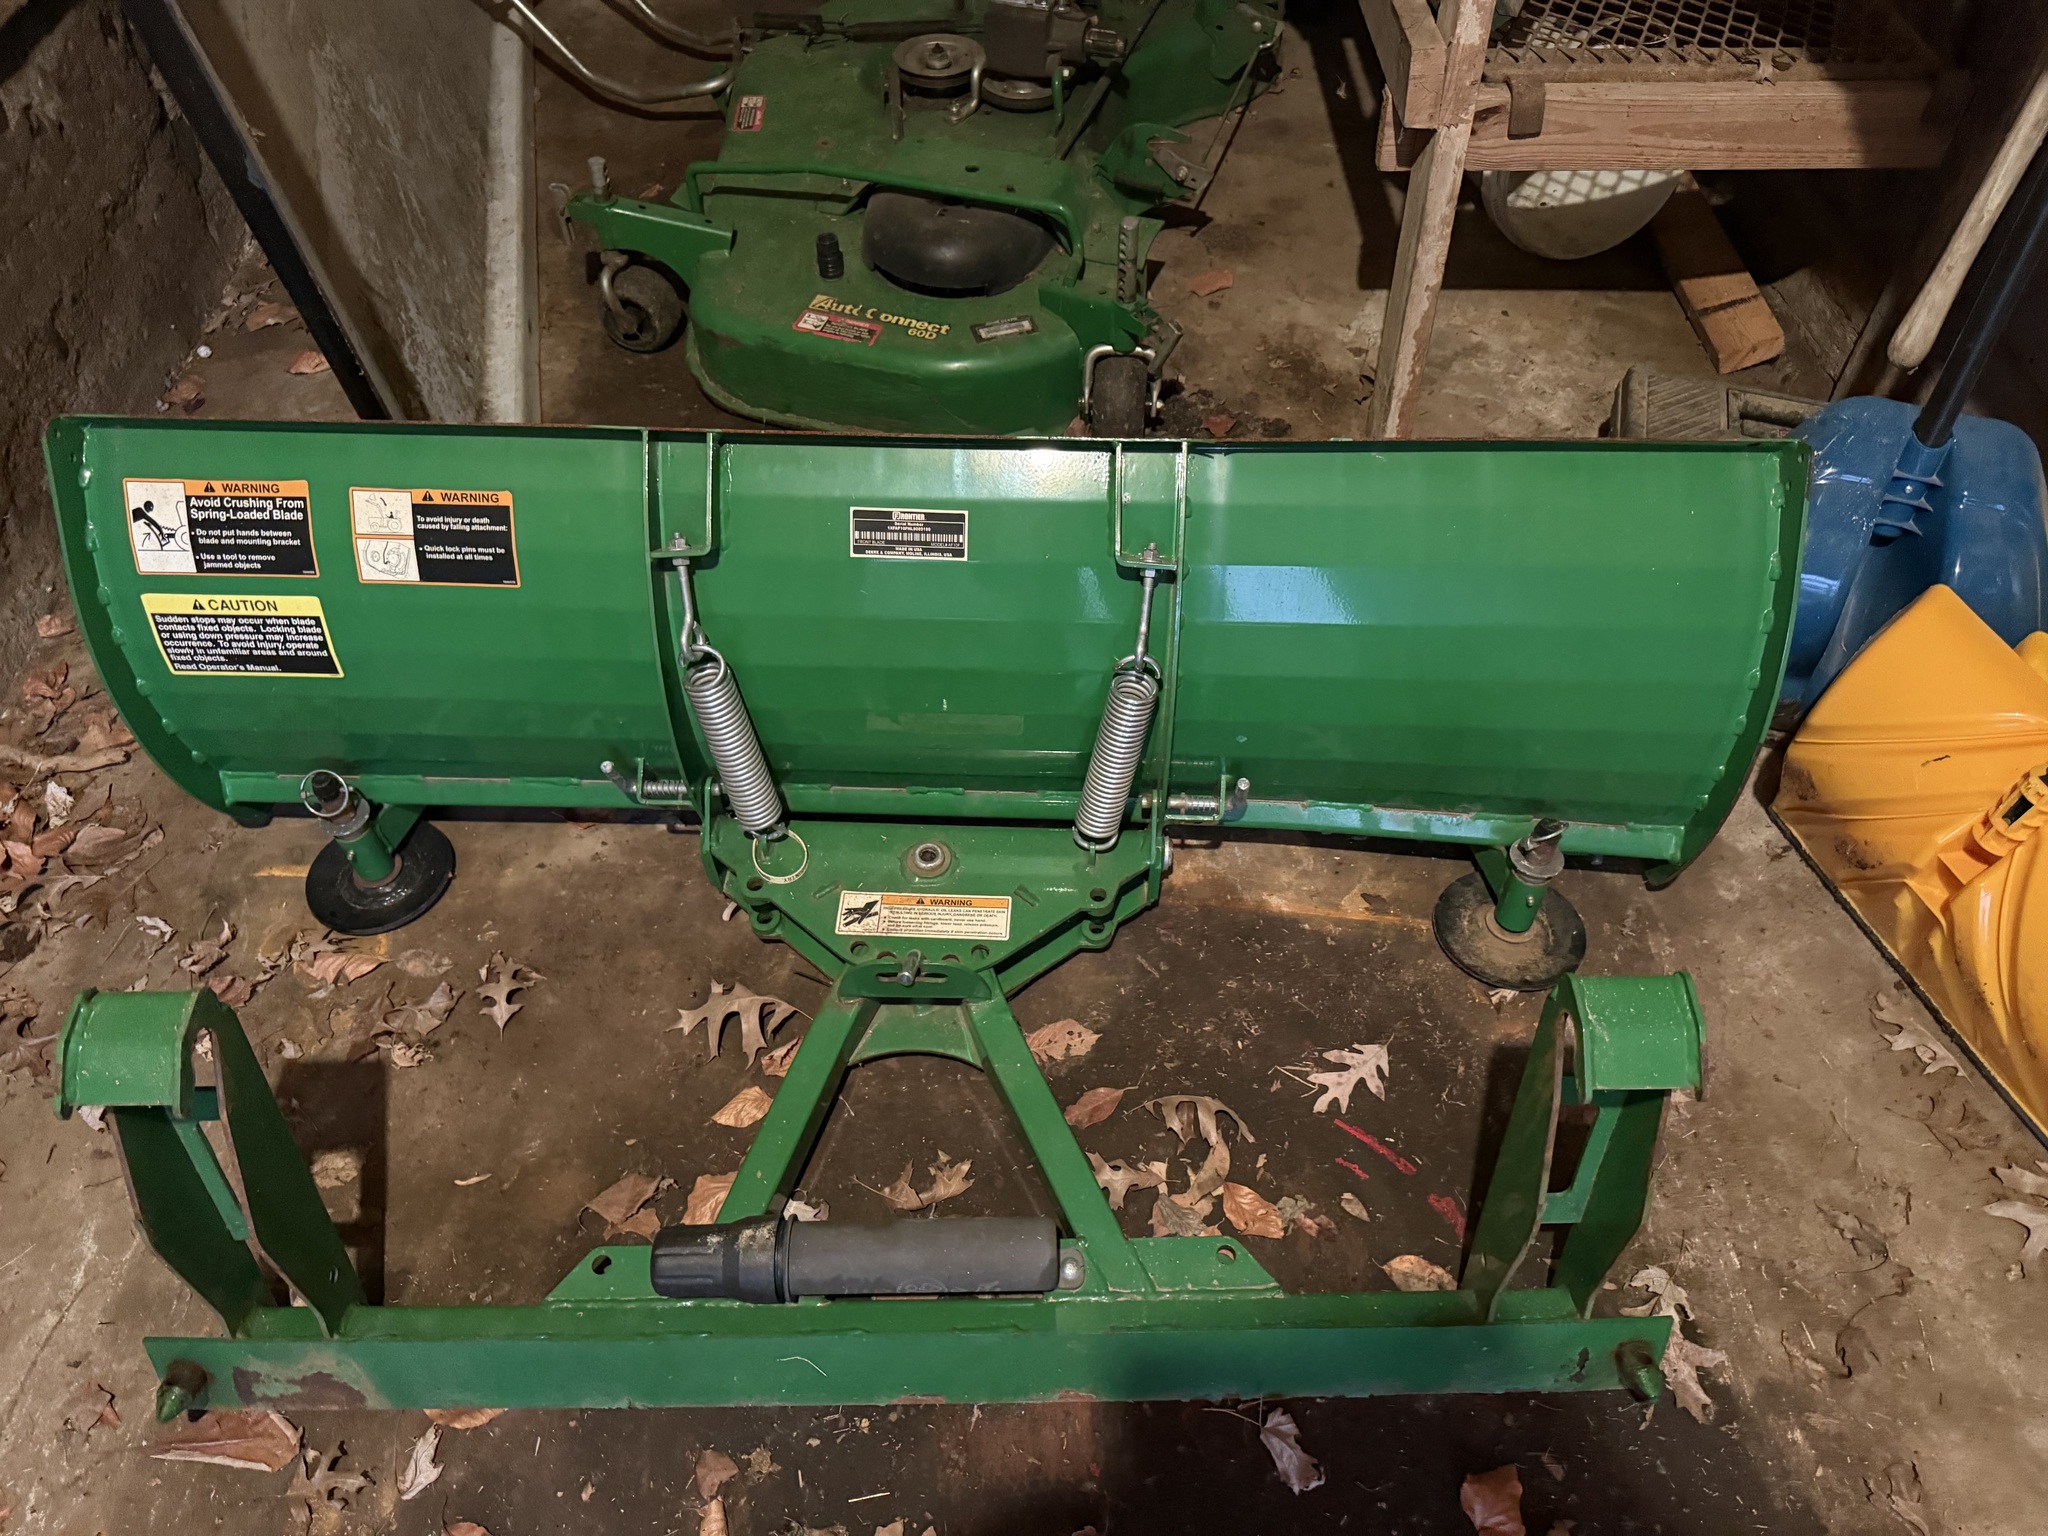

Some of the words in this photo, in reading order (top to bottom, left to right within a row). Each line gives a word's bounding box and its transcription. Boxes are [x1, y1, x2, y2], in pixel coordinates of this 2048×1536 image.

[908, 328, 937, 340] 60D
[222, 483, 280, 494] WARNING
[440, 492, 499, 503] WARNING
[190, 496, 221, 508] Avoid
[223, 497, 273, 511] Crushing
[276, 497, 305, 509] From
[190, 508, 270, 522] Spring-Loaded
[273, 509, 304, 521] Blade
[445, 516, 463, 524] injury
[892, 511, 926, 521] FRONTIER
[196, 528, 207, 536] Do
[222, 529, 235, 537] put
[236, 529, 259, 537] hands
[261, 529, 292, 537] between
[441, 523, 449, 531] by
[450, 524, 471, 532] falling
[471, 524, 508, 532] attachment:
[198, 537, 219, 545] blade
[221, 537, 235, 545] and
[236, 538, 272, 547] mounting
[273, 538, 301, 546] bracket
[200, 552, 216, 560] Use
[223, 553, 237, 561] tool
[239, 553, 247, 561] to
[426, 552, 455, 560] installed
[203, 560, 233, 570] jammed
[235, 561, 262, 570] objects
[208, 599, 278, 612] CAUTION
[155, 614, 189, 623] Sudden
[191, 616, 216, 624] stops
[217, 617, 236, 625] may
[265, 617, 290, 625] when
[290, 617, 316, 625] blade
[158, 623, 196, 632] contacts
[197, 624, 220, 632] fixed
[221, 624, 257, 633] objects.
[260, 625, 296, 635] Locking
[297, 626, 322, 634] blade
[172, 632, 198, 641] using
[265, 634, 284, 642] may
[285, 633, 324, 642] increase
[163, 640, 216, 648] occurrence.
[217, 640, 230, 648] To
[231, 641, 256, 649] avoid
[256, 641, 285, 650] injury,
[195, 647, 206, 655] in
[278, 649, 296, 657] and
[193, 655, 229, 663] objects.
[173, 662, 197, 670] Read
[198, 663, 245, 671] Operator's
[246, 663, 282, 672] Manual.
